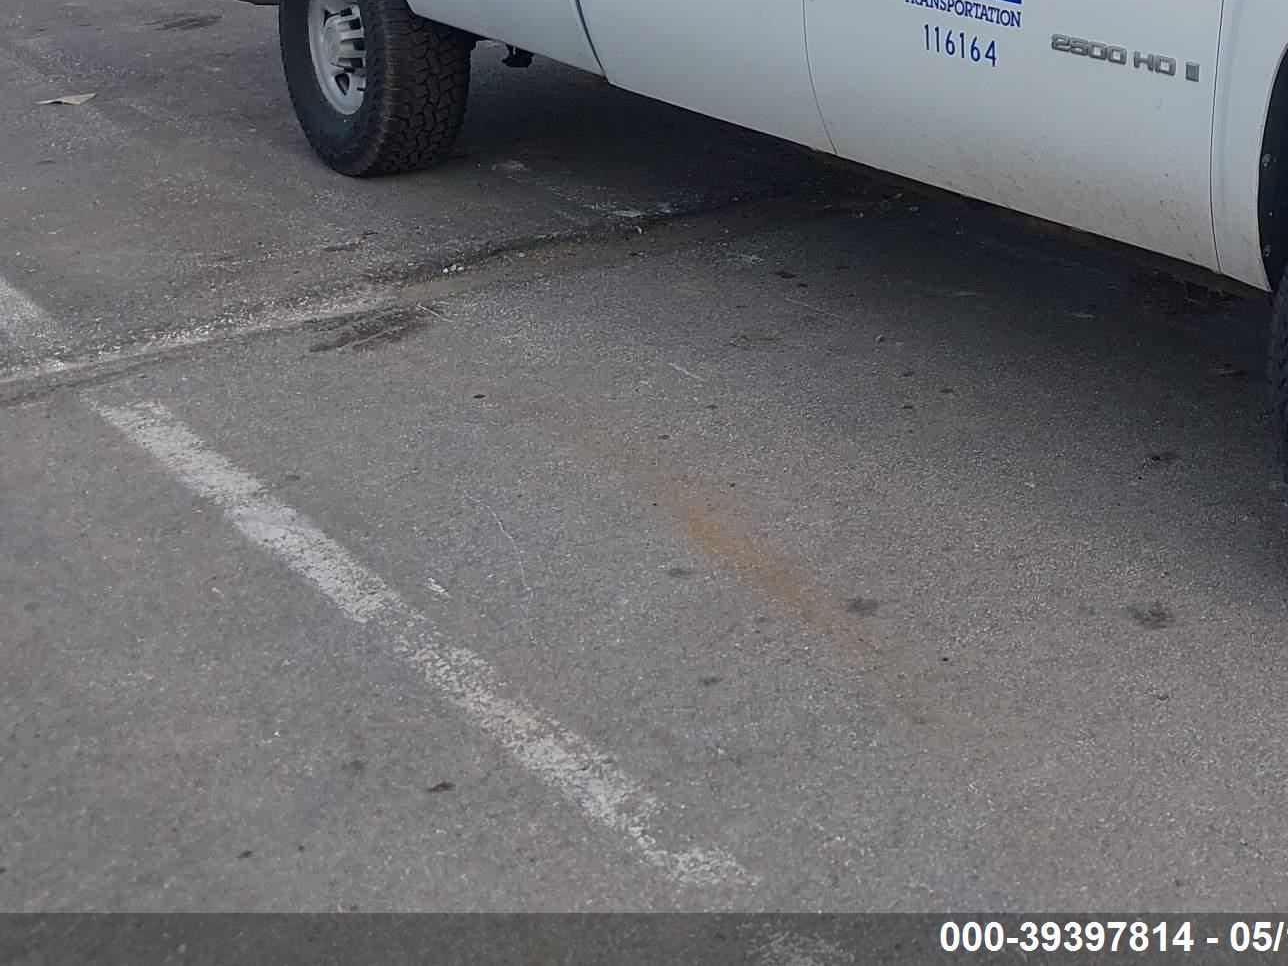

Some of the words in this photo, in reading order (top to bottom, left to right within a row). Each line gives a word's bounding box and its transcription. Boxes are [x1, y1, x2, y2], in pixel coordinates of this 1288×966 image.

[924, 24, 997, 68] 116164
[1051, 34, 1128, 66] 2500
[1133, 50, 1177, 76] HD
